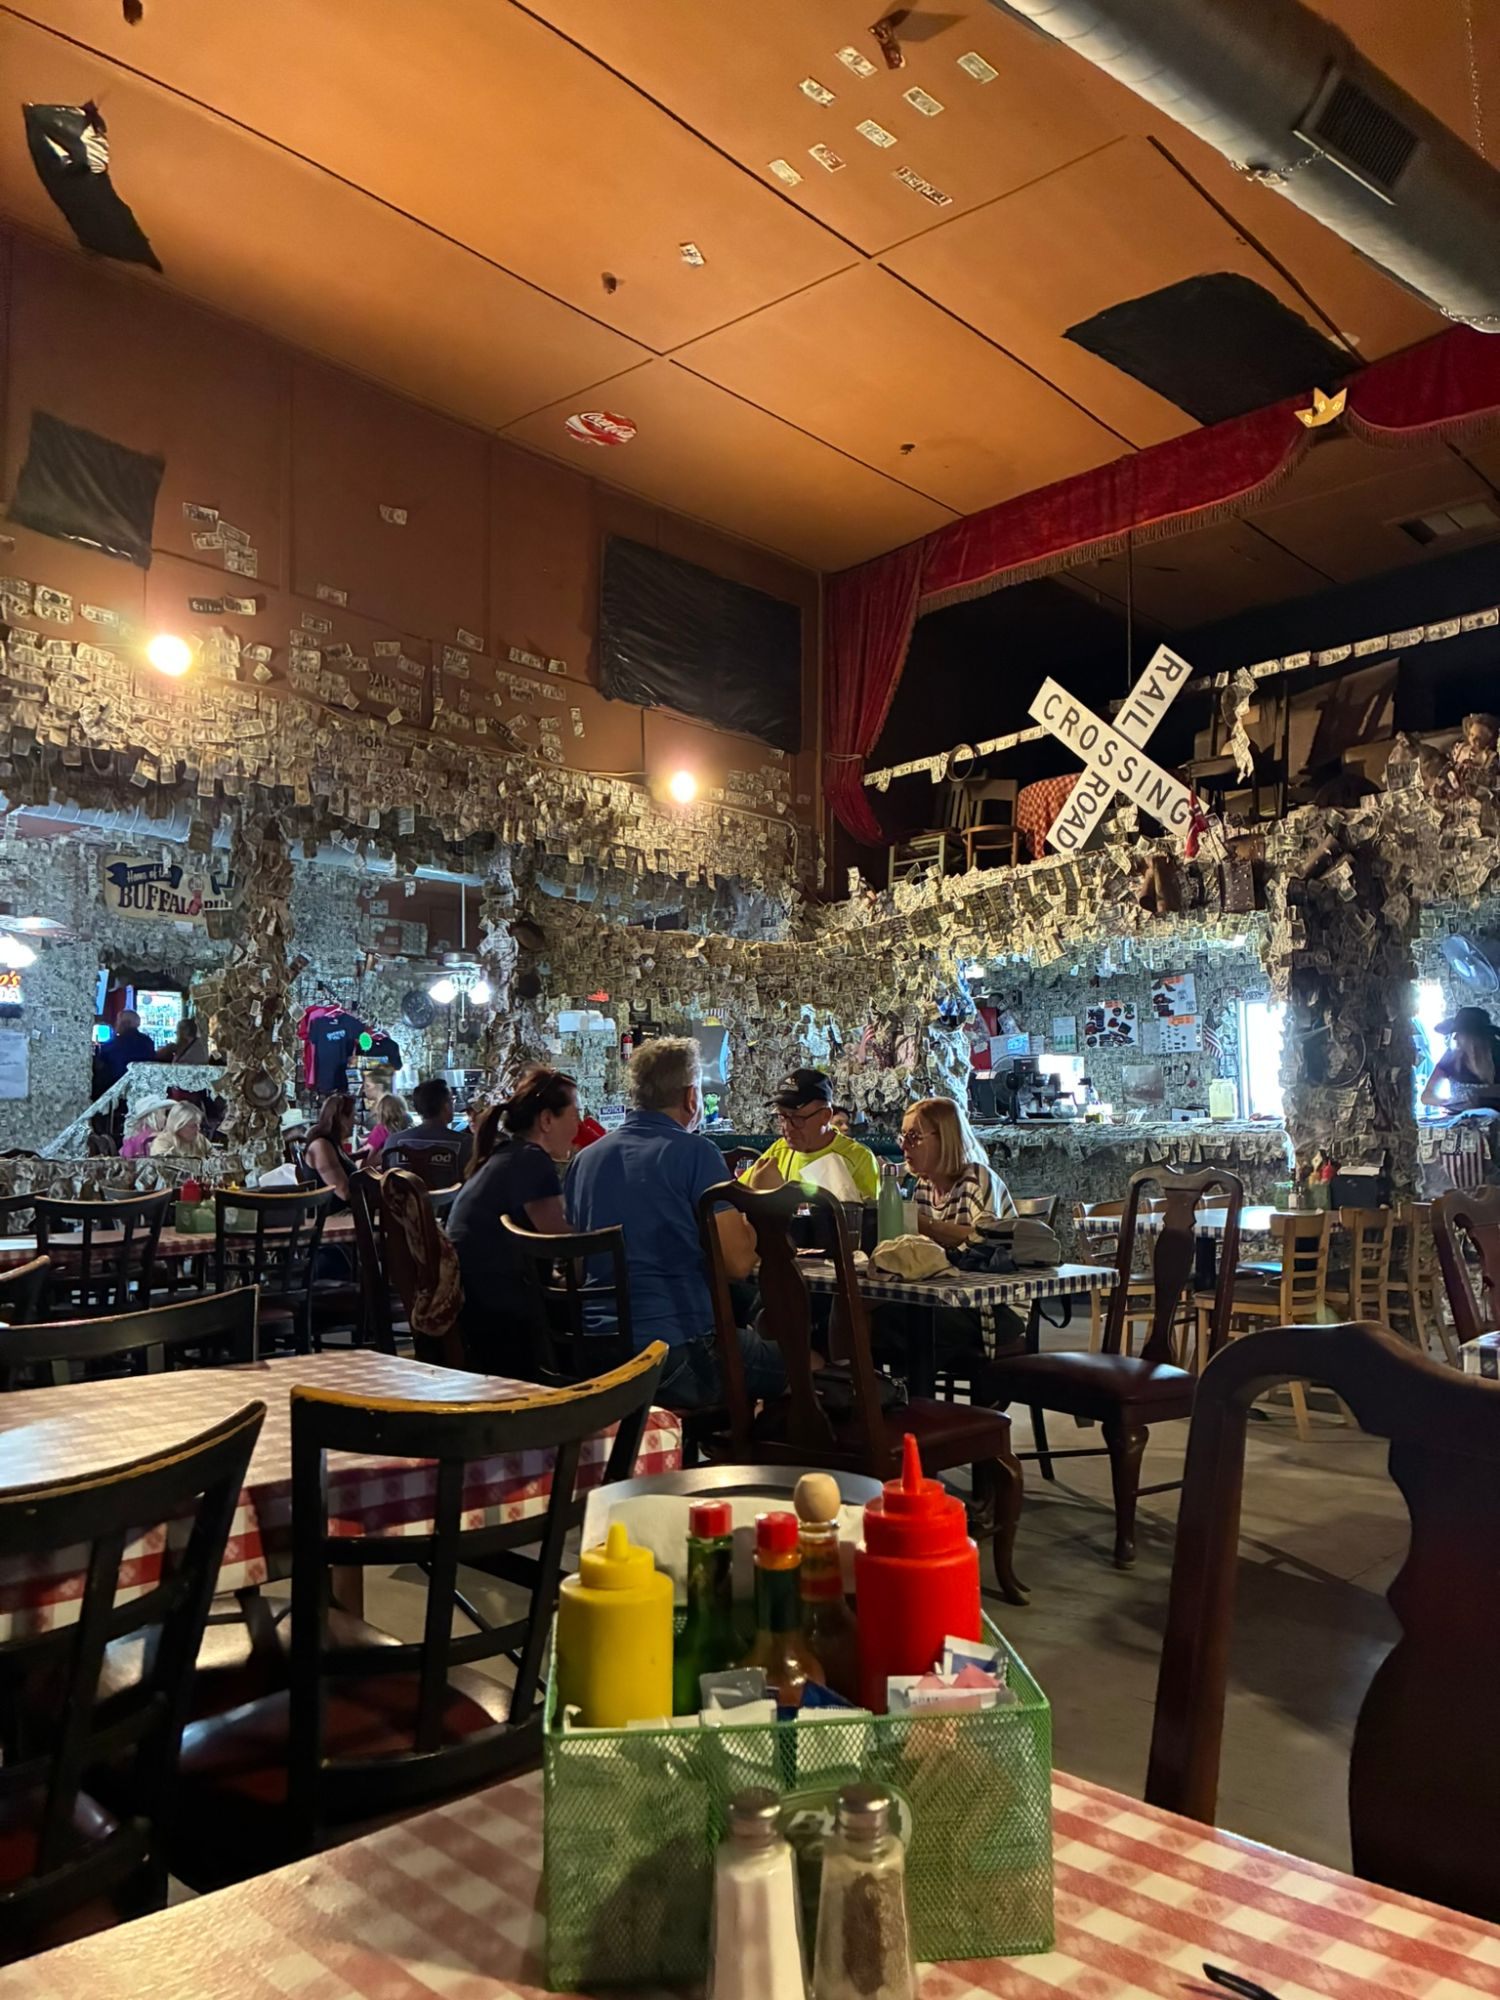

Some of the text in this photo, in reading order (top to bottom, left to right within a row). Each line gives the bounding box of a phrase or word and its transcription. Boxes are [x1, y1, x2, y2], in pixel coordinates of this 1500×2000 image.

[1043, 694, 1193, 825] CROSSING
[1056, 653, 1184, 850] RAIL ROAD
